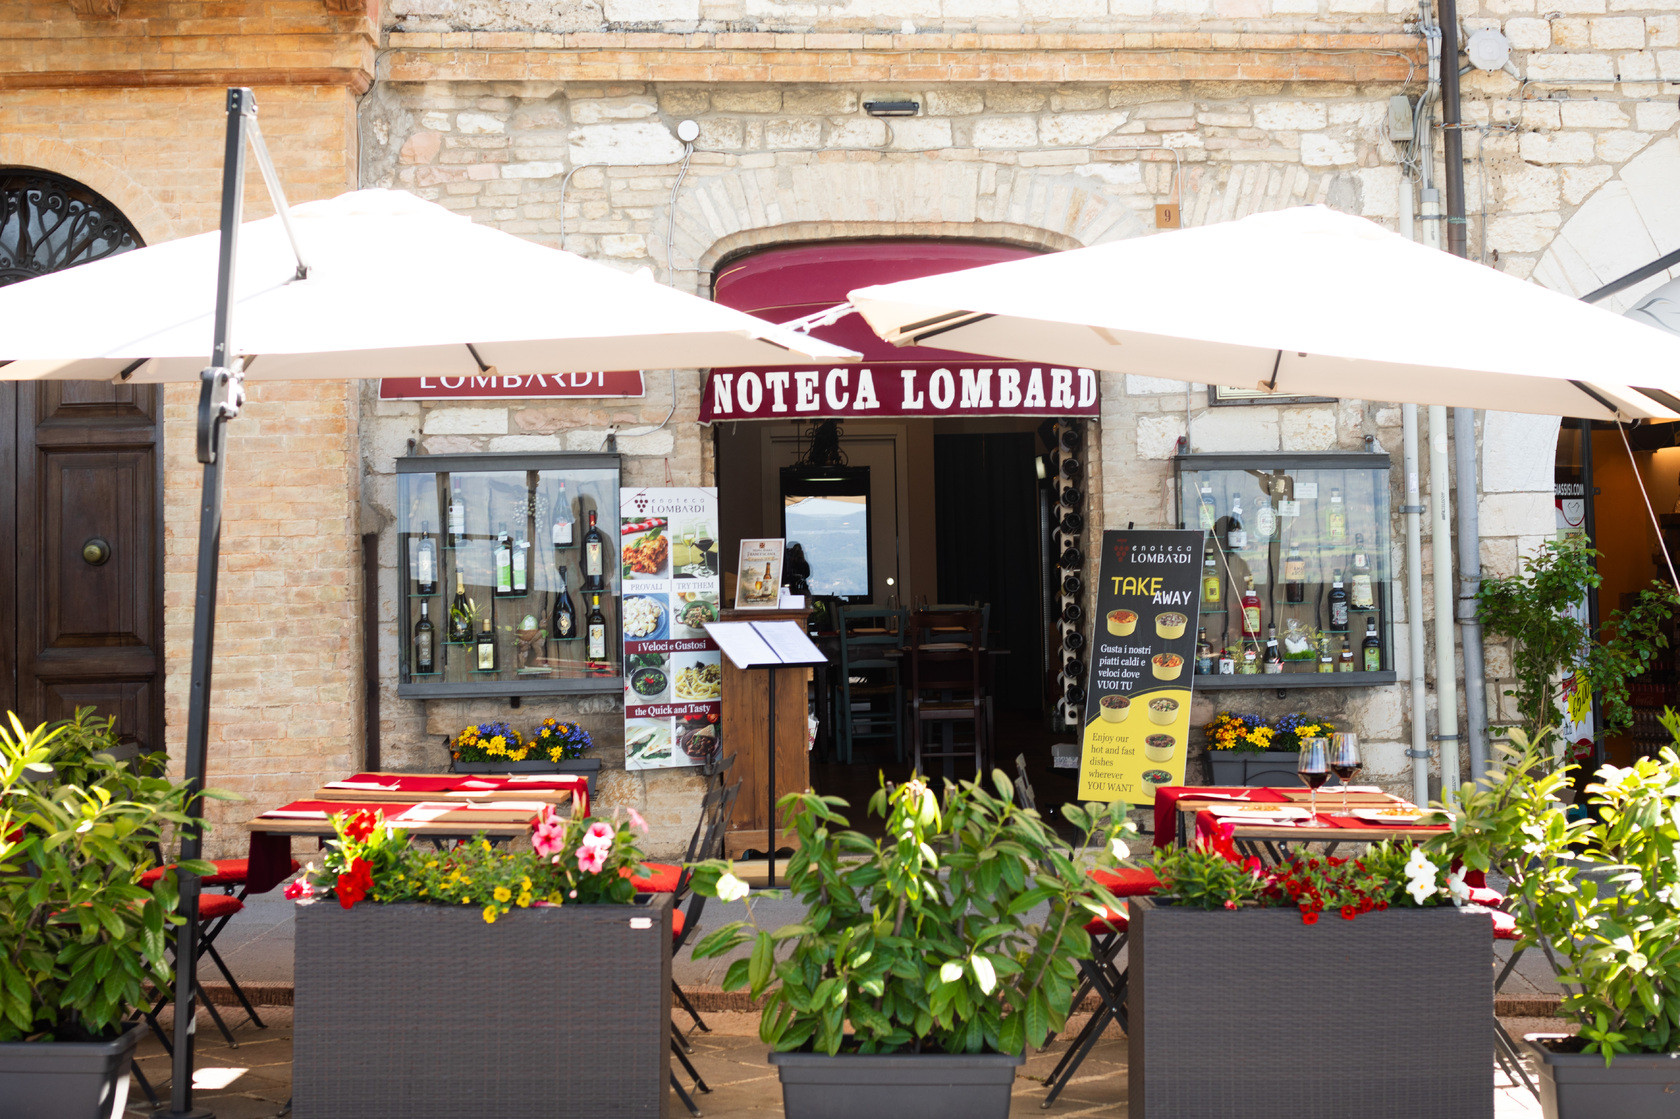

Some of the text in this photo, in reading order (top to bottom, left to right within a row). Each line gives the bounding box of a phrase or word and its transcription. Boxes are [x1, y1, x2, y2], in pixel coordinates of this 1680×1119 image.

[1164, 208, 1171, 222] 9
[713, 367, 1097, 414] NOTECA LOMBARD
[651, 505, 705, 513] LOMBARDI
[1131, 553, 1191, 564] LOMBARDI
[630, 583, 663, 591] PROVALI
[676, 582, 692, 590] TRY
[1111, 576, 1164, 596] TAKE
[1152, 590, 1192, 605] AWAY
[642, 641, 668, 652] Veloci
[675, 640, 706, 650] Gustosi
[1100, 644, 1123, 654] Gusta
[1128, 645, 1151, 655] nostri
[1099, 656, 1120, 667] piatti
[1121, 656, 1140, 666] caldi
[1098, 668, 1140, 678] veloci dove
[1097, 680, 1133, 690] VUOI TU
[635, 703, 711, 716] the Quick and Tasty
[1092, 733, 1129, 744] Enjoy our
[1091, 745, 1135, 756] hot and fast
[1089, 757, 1114, 767] dishes
[1088, 769, 1124, 780] wherever
[1087, 781, 1134, 793] YOU WANT
